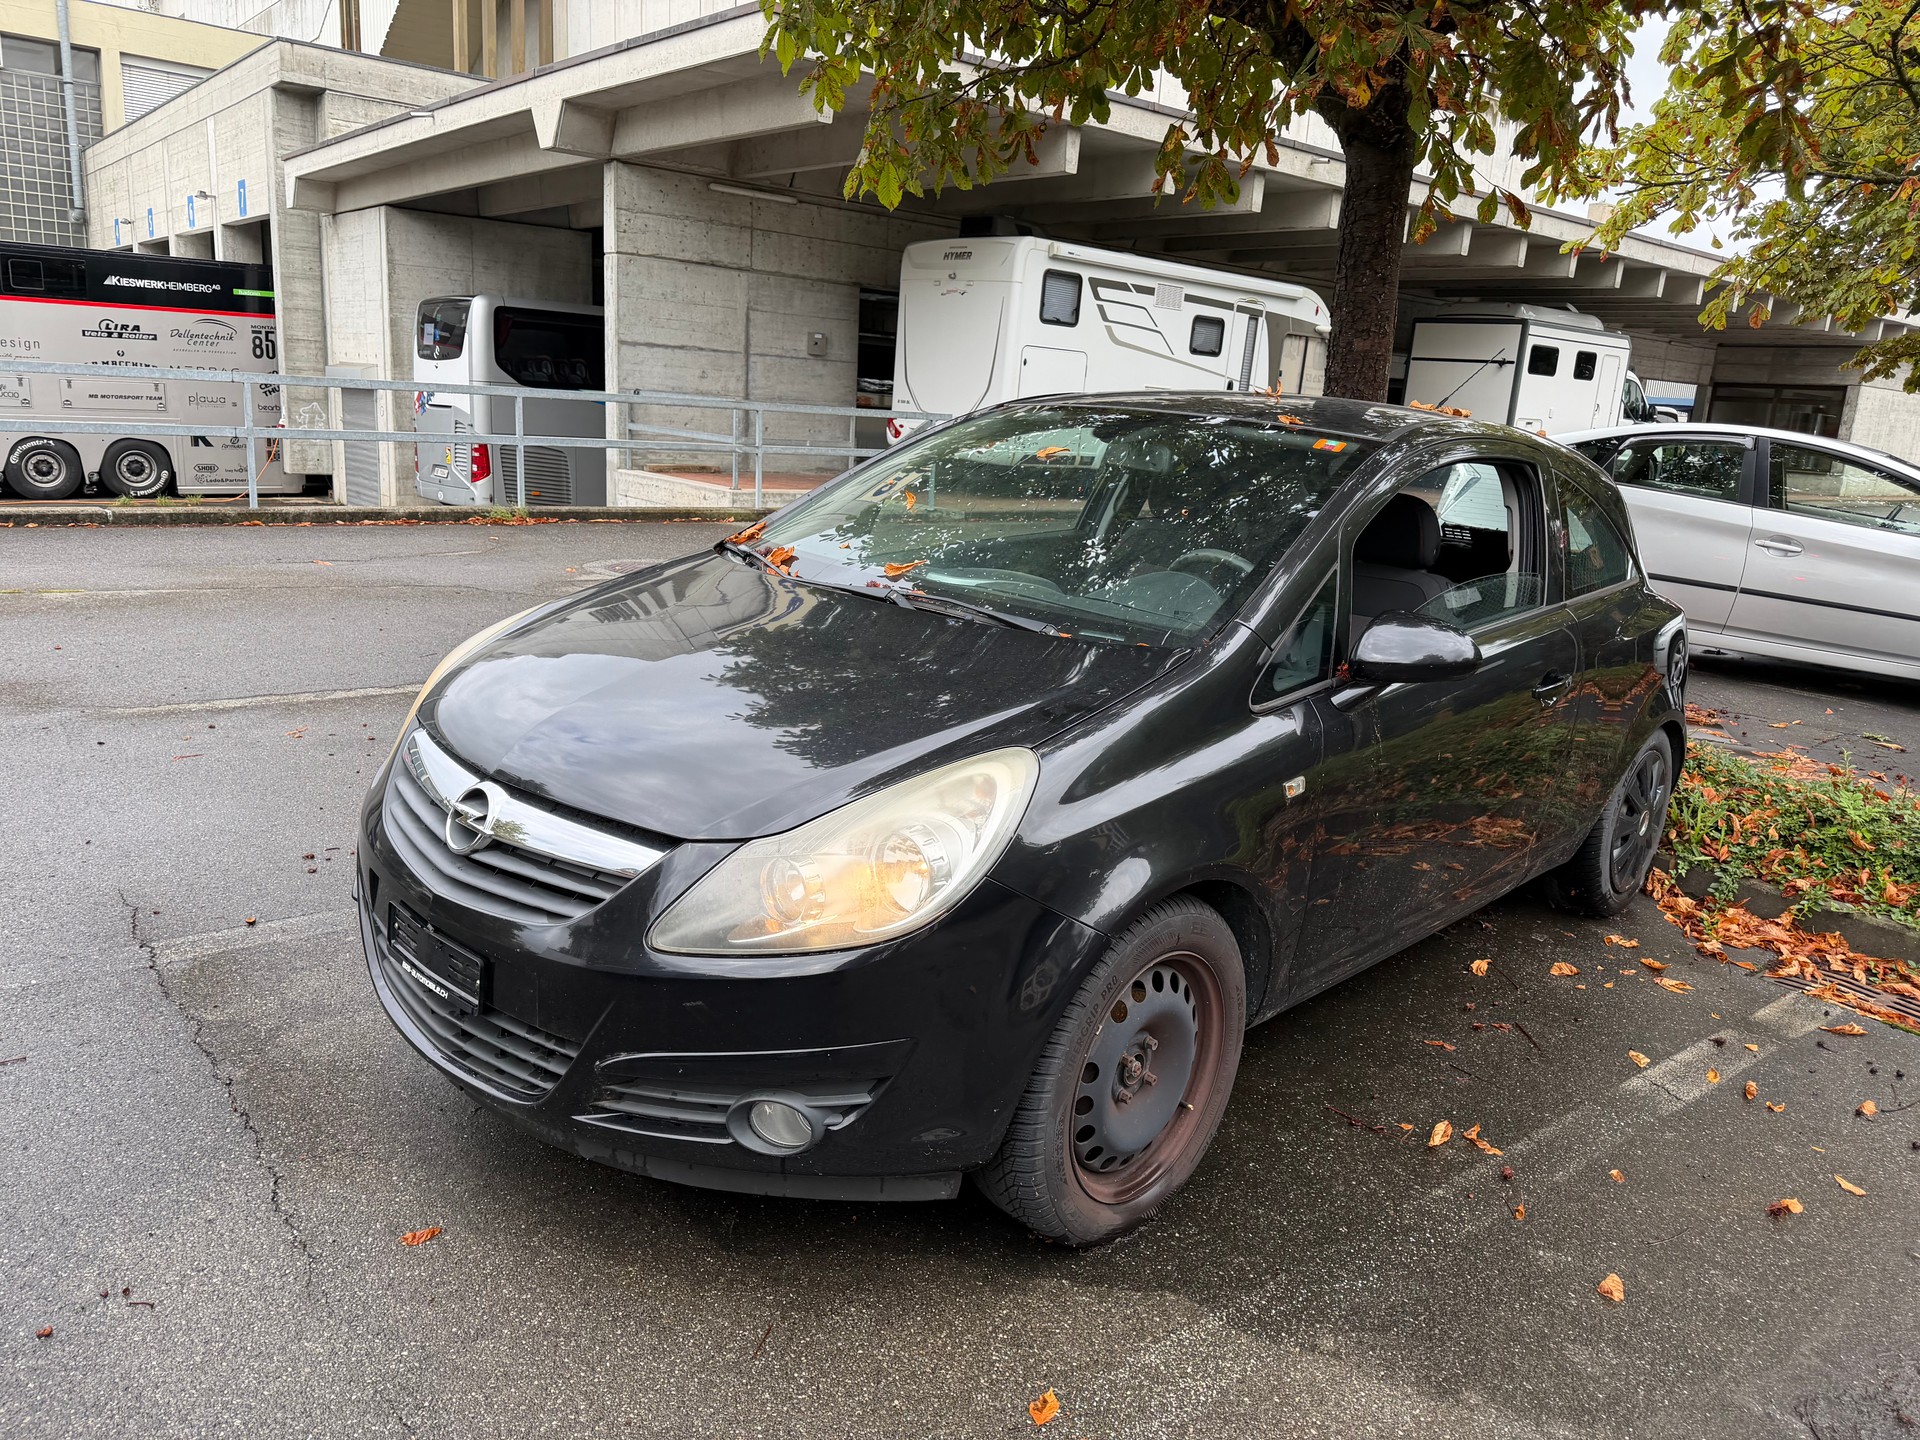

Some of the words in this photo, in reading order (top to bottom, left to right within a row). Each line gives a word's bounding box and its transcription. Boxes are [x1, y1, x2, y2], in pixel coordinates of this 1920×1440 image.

[943, 251, 973, 261] HYMER
[103, 321, 141, 332] LIRA
[121, 332, 155, 340] Roller
[169, 328, 234, 341] Dellentechnik
[187, 339, 220, 347] Center
[1064, 1003, 1100, 1083] SUPERGRIP
[1101, 975, 1119, 1001] PRO
